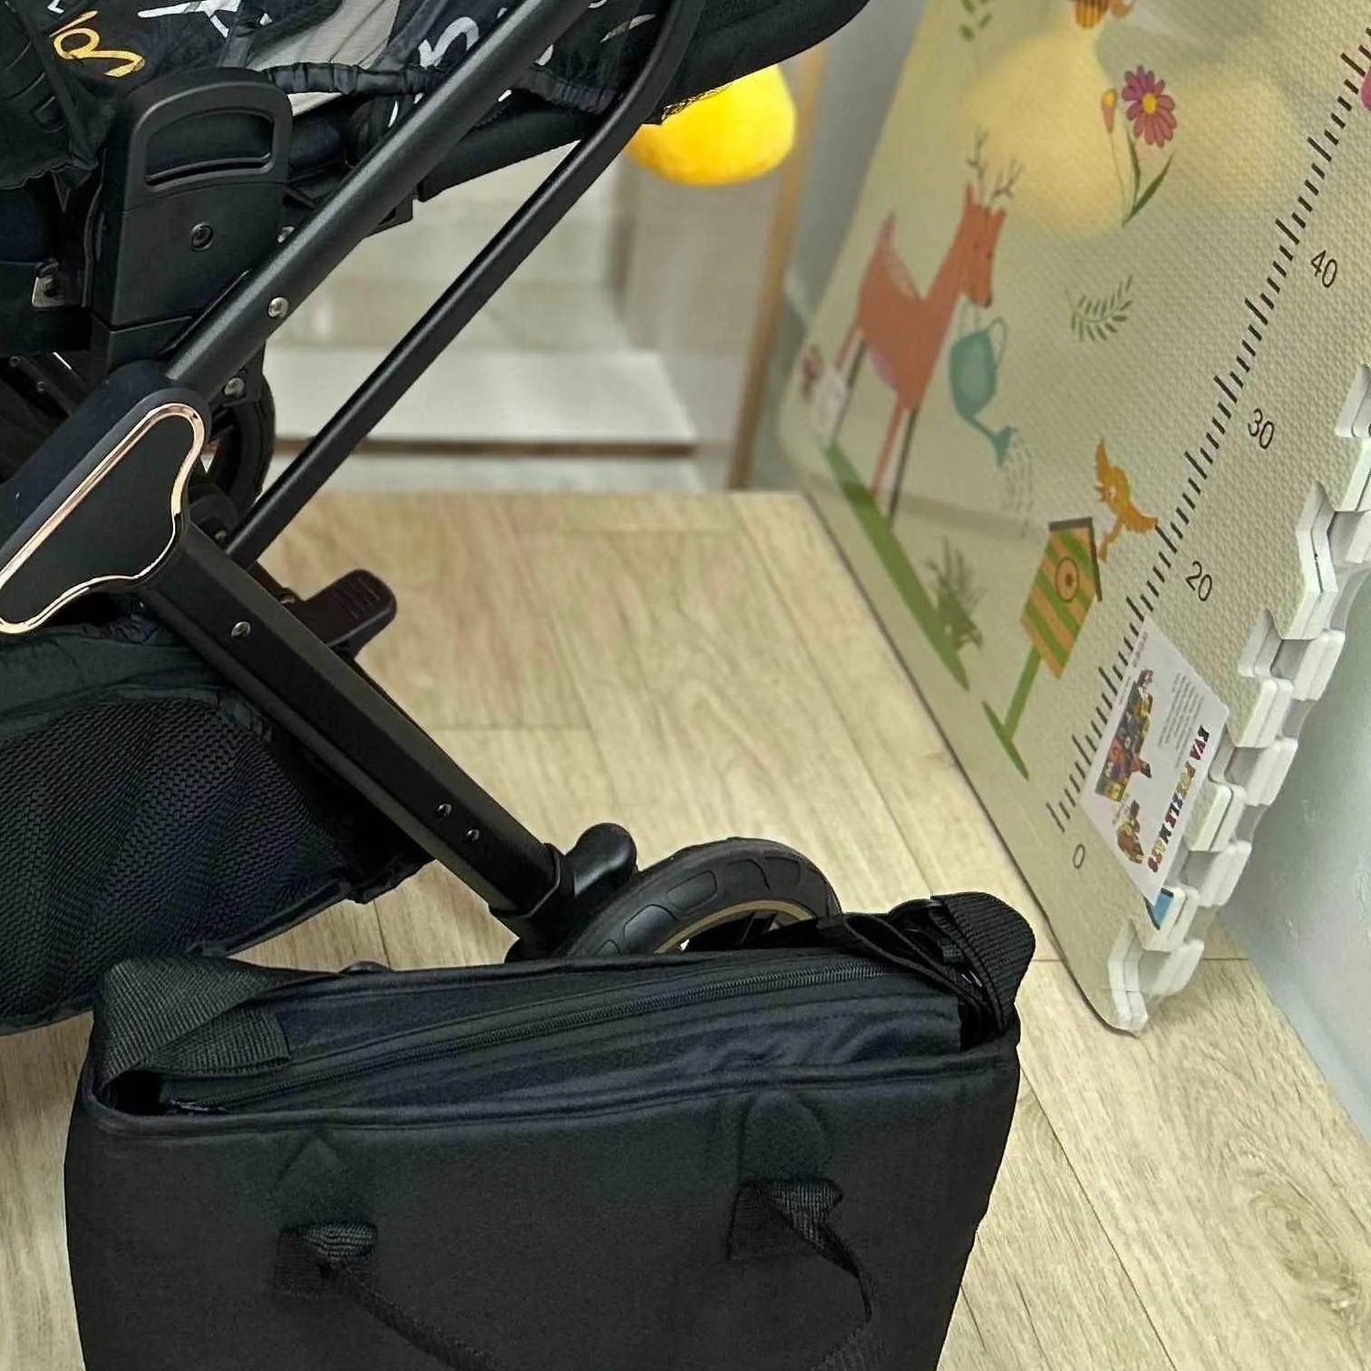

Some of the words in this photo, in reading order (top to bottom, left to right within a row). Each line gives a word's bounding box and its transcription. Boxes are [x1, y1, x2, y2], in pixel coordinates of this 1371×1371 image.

[1310, 249, 1338, 288] 40
[1247, 408, 1276, 449] 30
[1185, 559, 1214, 602] 20
[1189, 724, 1210, 761] EVA
[1072, 842, 1086, 870] 0
